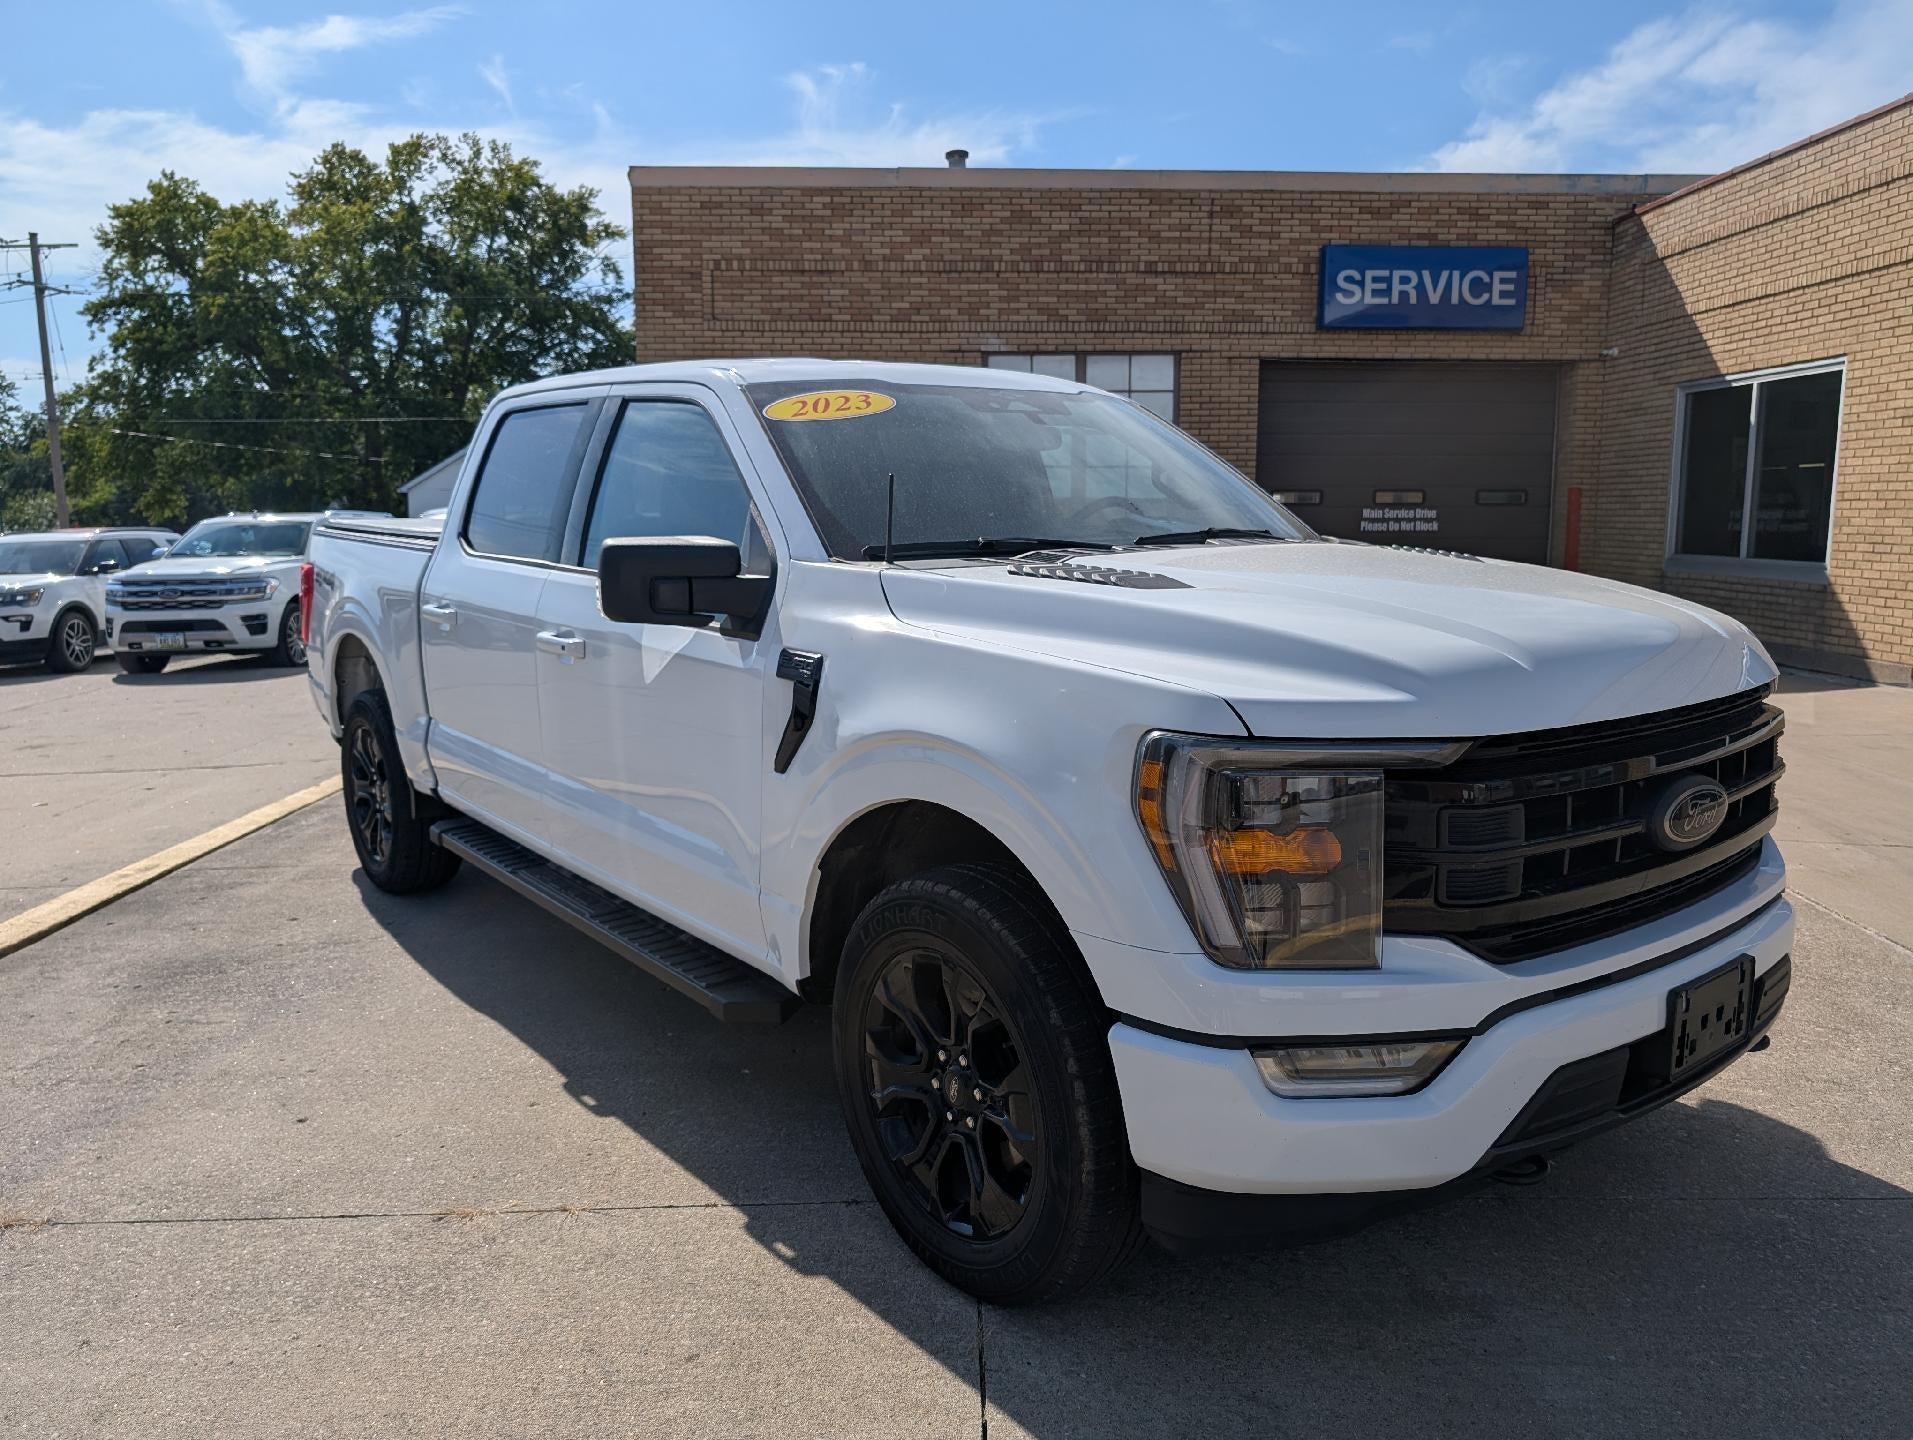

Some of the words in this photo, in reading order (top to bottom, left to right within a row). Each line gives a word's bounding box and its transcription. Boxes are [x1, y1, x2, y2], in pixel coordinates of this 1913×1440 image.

[1335, 269, 1517, 305] SERVICE
[791, 394, 872, 417] 2023
[1363, 508, 1383, 519] Main
[1384, 508, 1414, 519] Service
[1415, 508, 1437, 519] Drive
[1360, 521, 1387, 532] Please
[1388, 521, 1399, 532] Do
[1400, 521, 1414, 532] Not
[1415, 521, 1439, 532] Block
[1683, 797, 1718, 832] Ford
